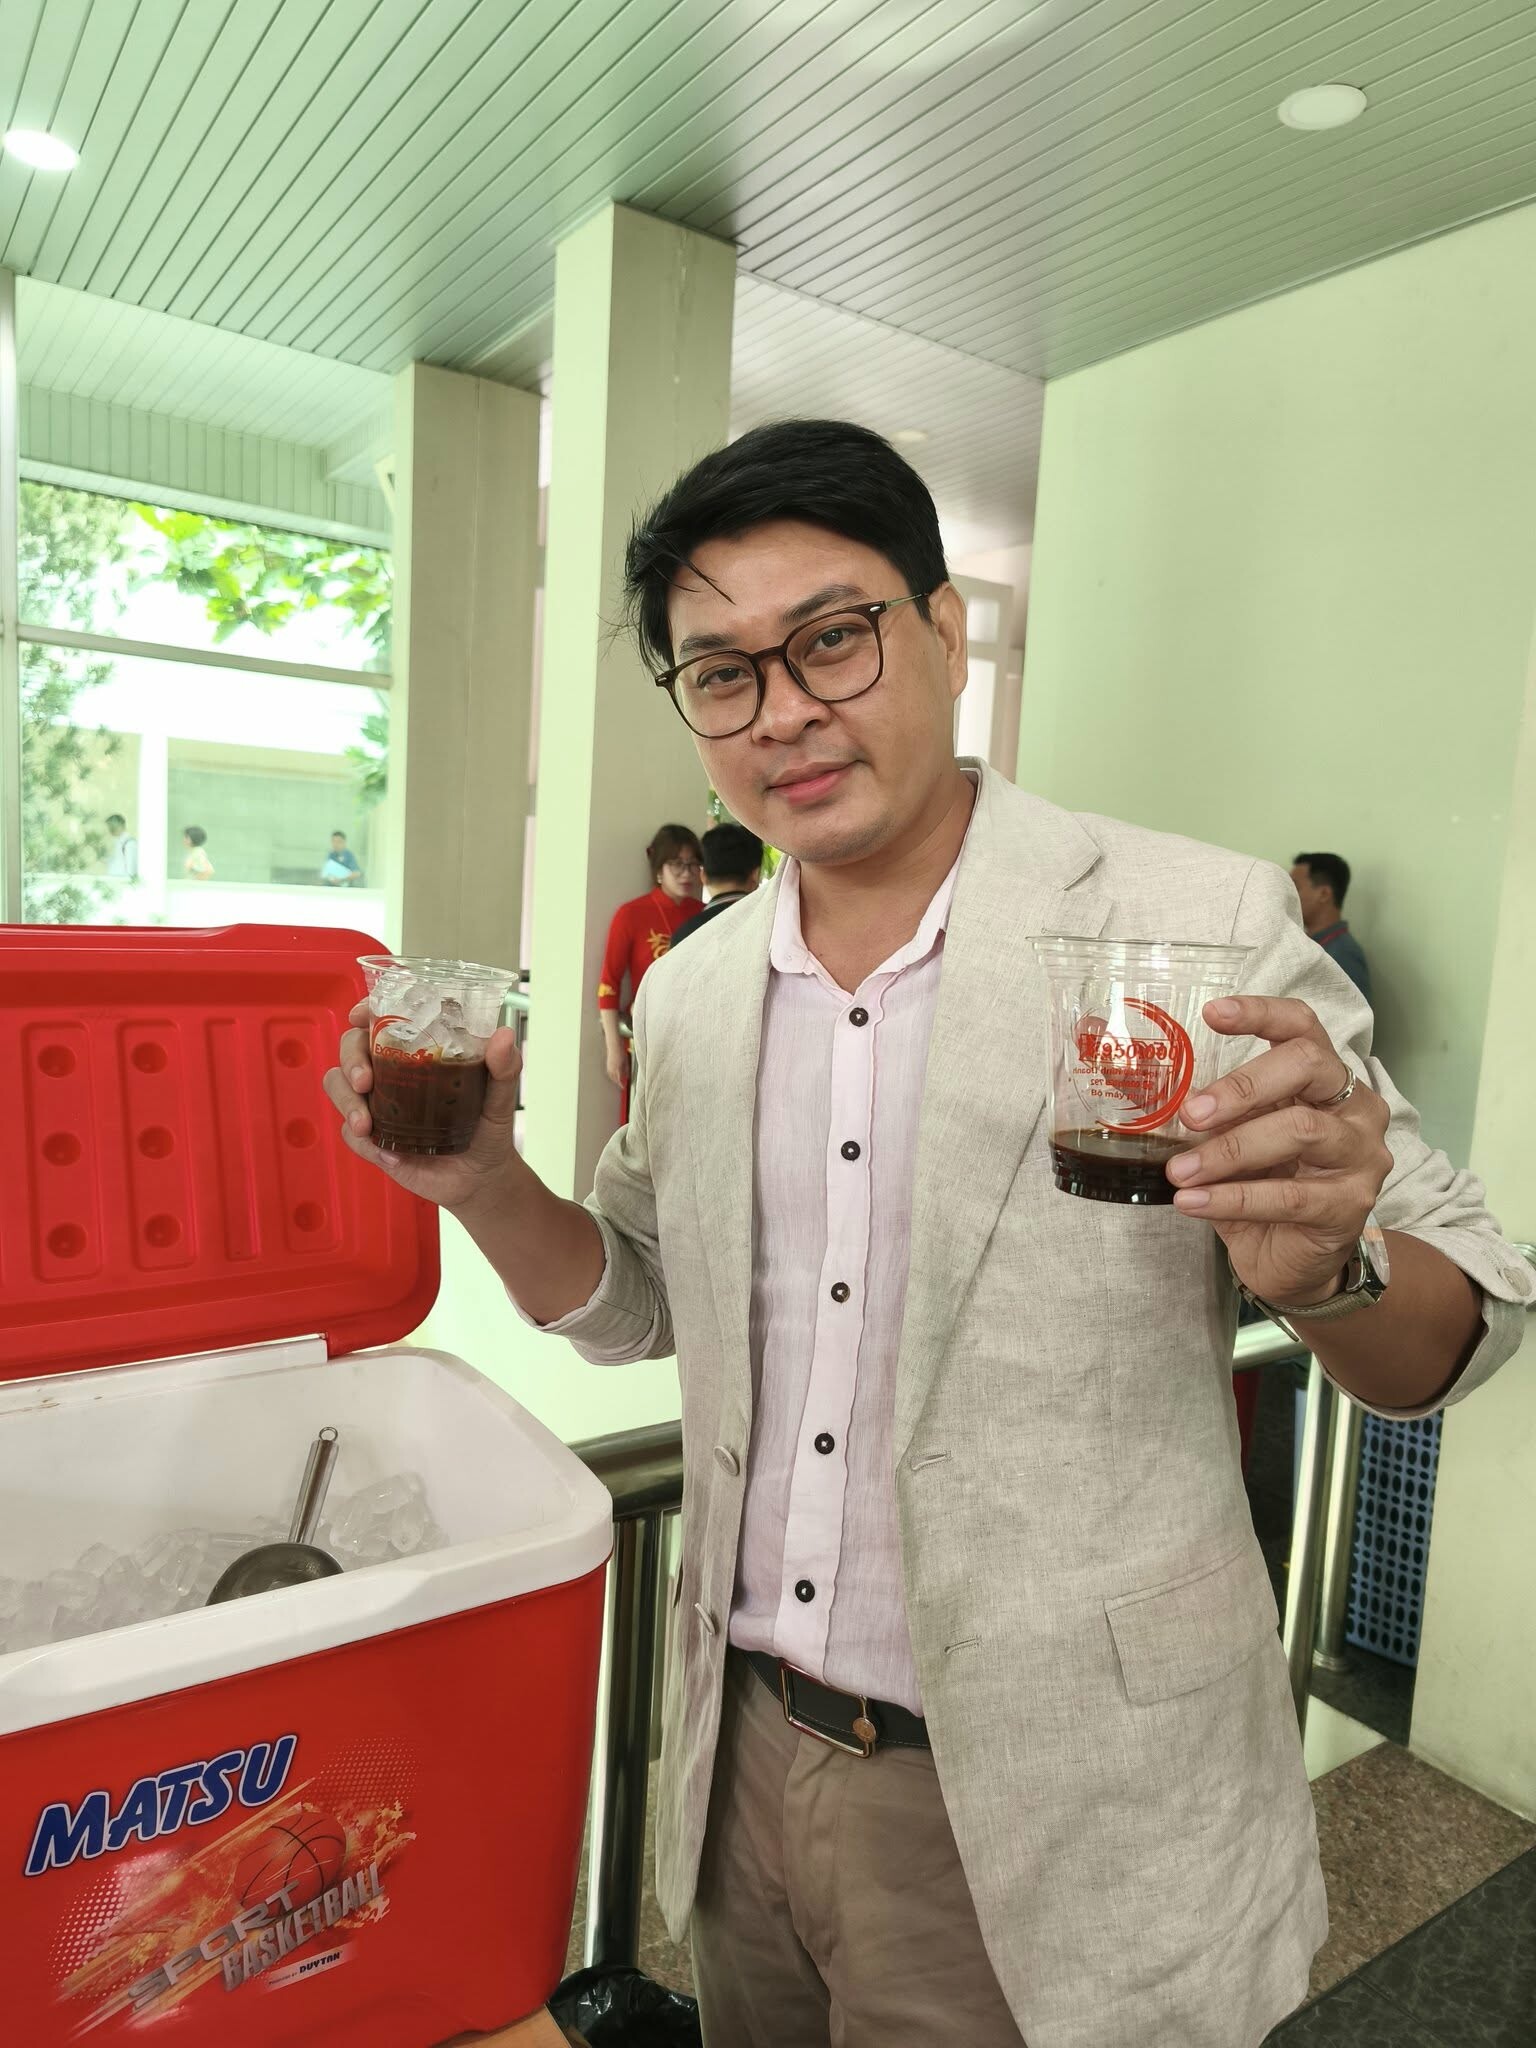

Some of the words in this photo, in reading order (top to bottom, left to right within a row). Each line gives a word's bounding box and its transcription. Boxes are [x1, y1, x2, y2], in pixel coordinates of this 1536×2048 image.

[25, 1734, 298, 1876] MATSU
[127, 1880, 300, 2012] SPORT
[222, 1862, 386, 1993] BASKETBALL
[299, 1952, 340, 1973] DUYTAN
